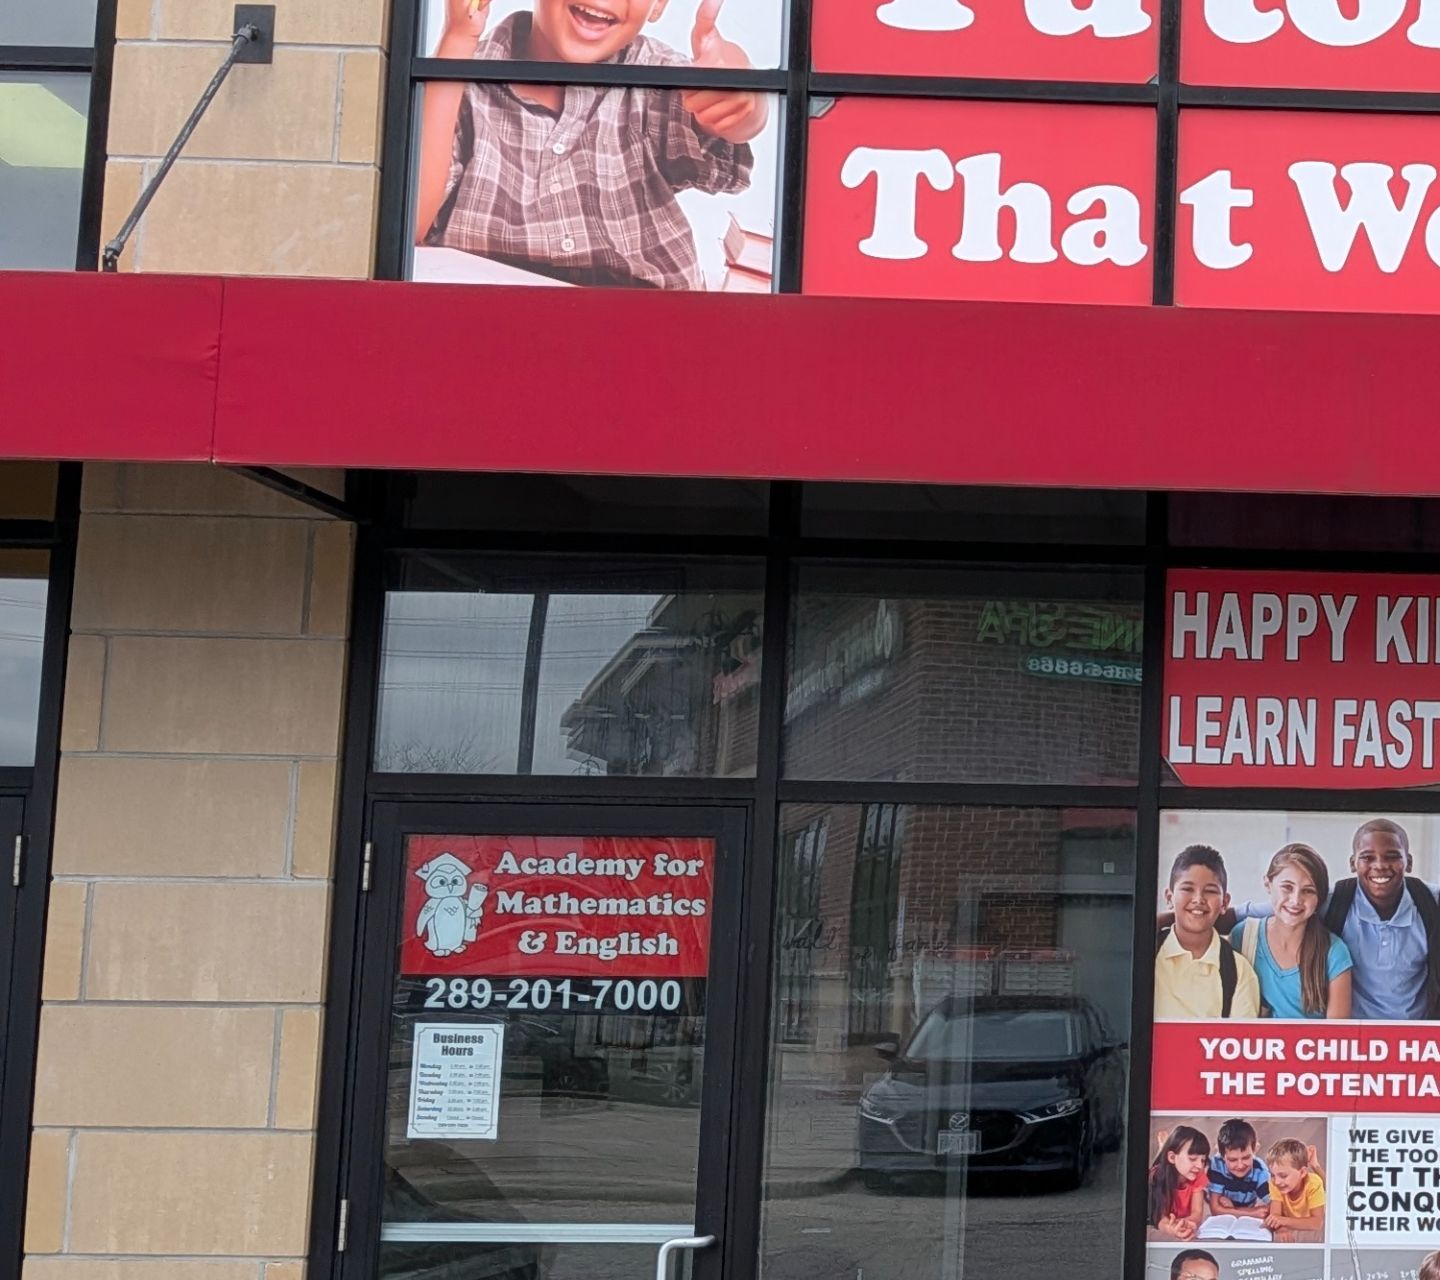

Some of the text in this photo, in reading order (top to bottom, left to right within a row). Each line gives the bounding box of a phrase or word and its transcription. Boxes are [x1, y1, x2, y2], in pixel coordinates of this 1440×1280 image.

[841, 145, 1254, 271] That
[1171, 590, 1358, 663] HAPPY
[1168, 695, 1317, 766] LEARN
[494, 851, 705, 881] Academy for
[495, 890, 707, 917] Mathematics
[517, 930, 680, 961] & English
[423, 977, 682, 1011] 289-201-7000
[433, 1032, 484, 1044] Business
[441, 1045, 474, 1056] Hours
[1199, 1037, 1286, 1062] YOUR
[1295, 1038, 1389, 1062] CHILD
[1200, 1071, 1266, 1096] THE
[1348, 1129, 1379, 1144] WE
[1385, 1129, 1434, 1144] GIVE
[1347, 1148, 1391, 1163] THE
[1348, 1166, 1404, 1188] LET
[1346, 1216, 1410, 1232] THEIR
